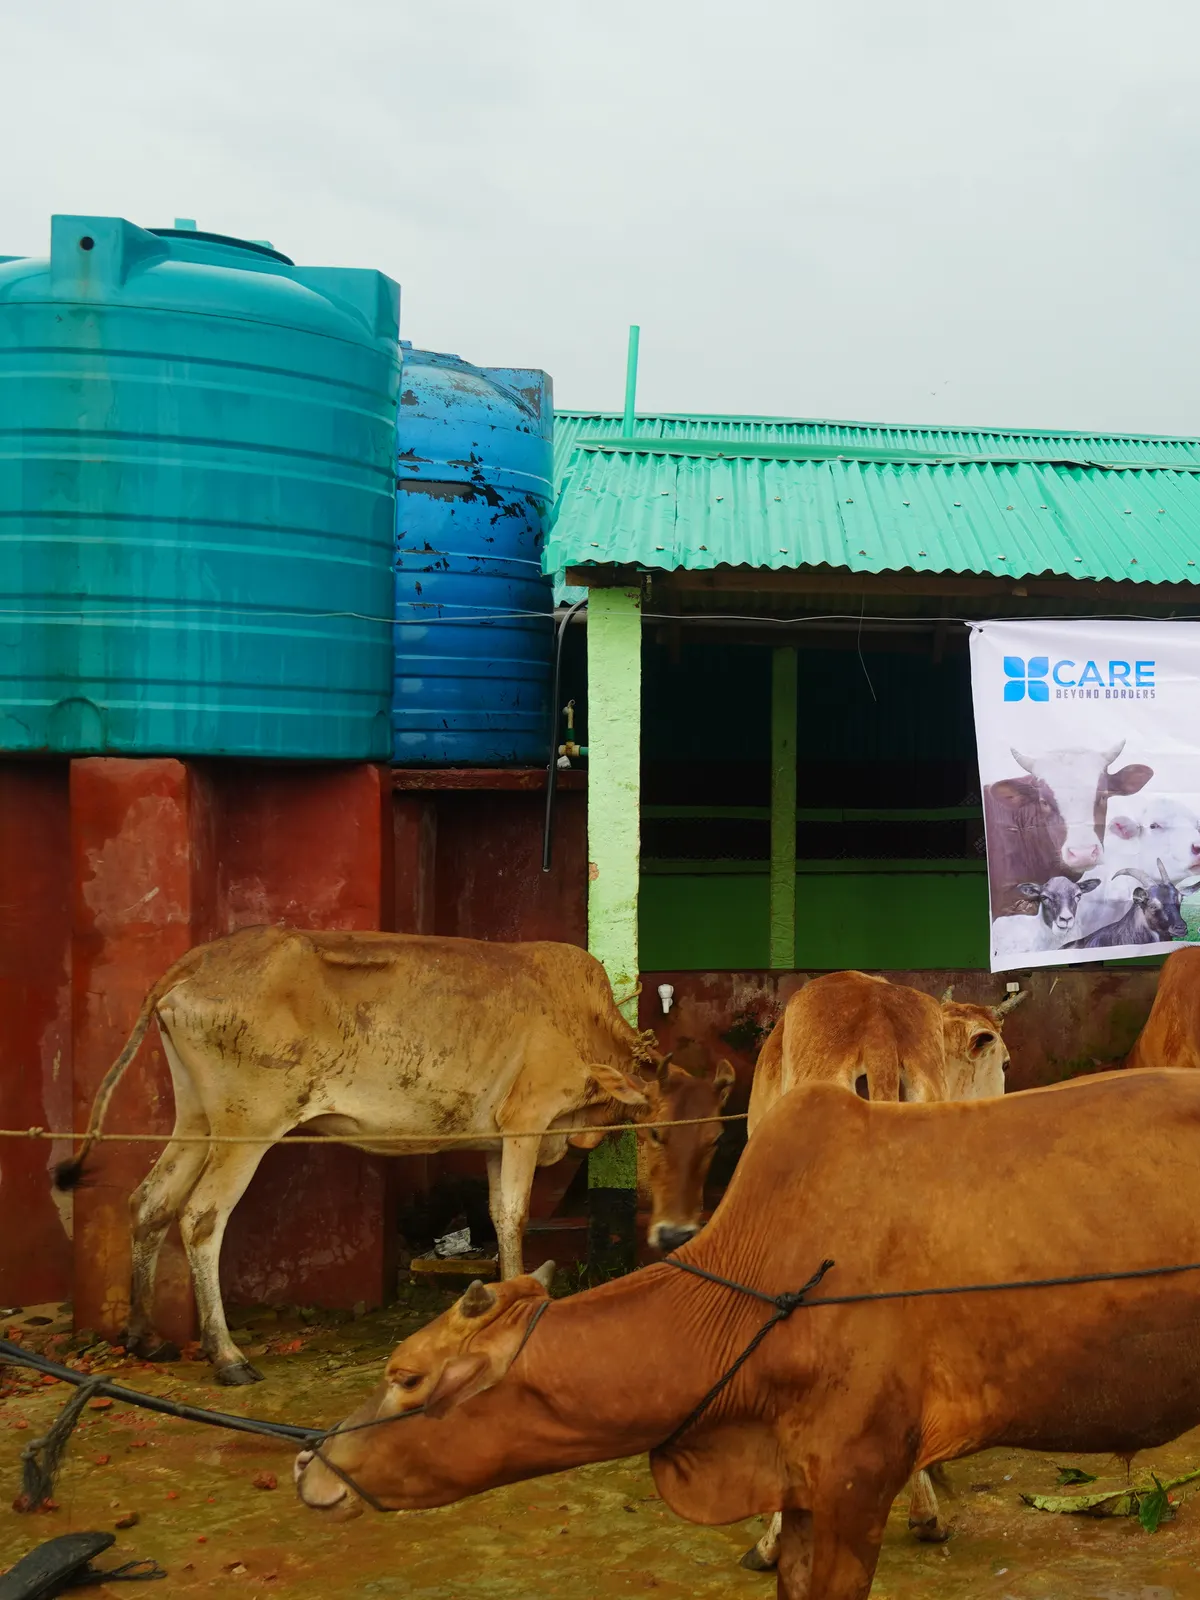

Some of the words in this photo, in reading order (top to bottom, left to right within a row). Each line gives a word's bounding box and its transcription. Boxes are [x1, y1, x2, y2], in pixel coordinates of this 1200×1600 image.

[1053, 660, 1156, 687] CARE
[1055, 688, 1100, 699] BEYOND
[1105, 688, 1156, 699] BORDERS
